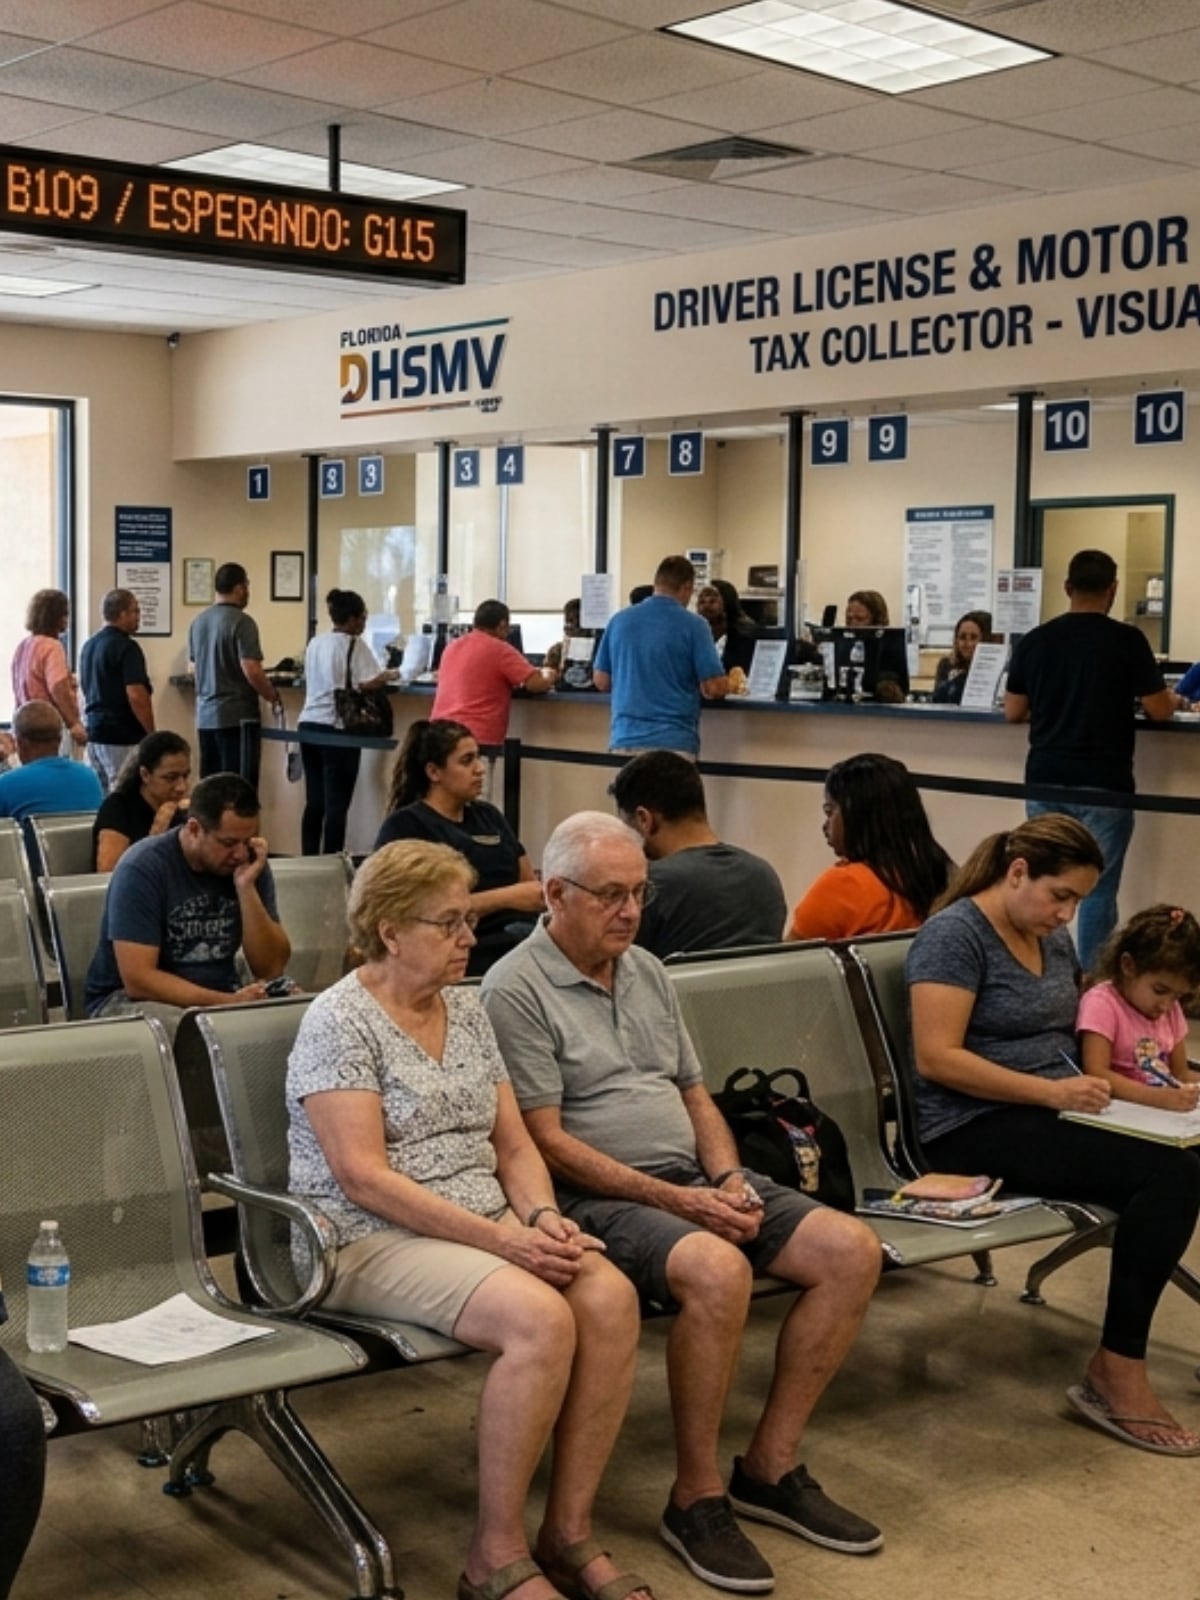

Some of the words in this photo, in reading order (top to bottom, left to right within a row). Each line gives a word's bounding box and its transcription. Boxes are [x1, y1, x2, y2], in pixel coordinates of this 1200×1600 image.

[7, 164, 99, 220] B109
[115, 182, 134, 225] /
[148, 183, 351, 251] ESPERANDO:
[363, 213, 436, 262] G115
[654, 276, 780, 332] DRIVER
[792, 248, 957, 315] LICENSE
[968, 243, 1002, 292] &
[1017, 215, 1189, 286] MOTOR
[340, 324, 402, 348] FLORIDA
[749, 331, 811, 374] TAX
[821, 304, 1034, 367] COLLECTOR
[1045, 319, 1063, 331] -
[1076, 283, 1200, 340] VISUA
[340, 333, 507, 405] DHSMV
[1048, 410, 1086, 443] 10
[1140, 402, 1180, 436] 10
[677, 439, 693, 466] 8
[820, 428, 838, 458] 9
[878, 423, 896, 454] 9
[459, 456, 474, 481] 3
[502, 453, 517, 477] 4
[620, 444, 636, 471] 7
[253, 473, 262, 493] 1
[364, 463, 377, 489] 3
